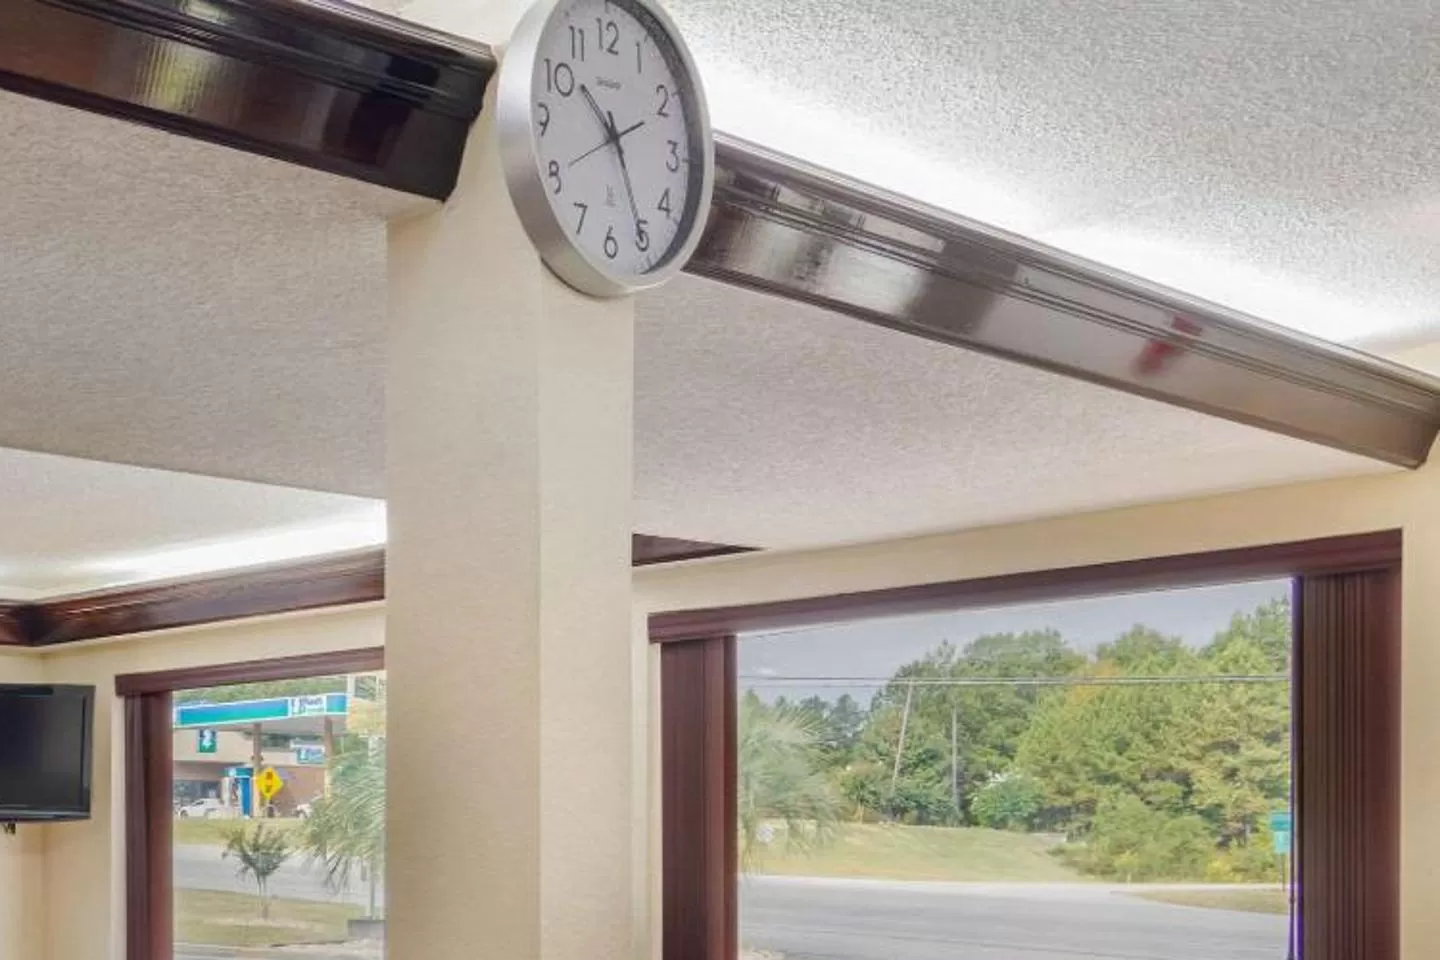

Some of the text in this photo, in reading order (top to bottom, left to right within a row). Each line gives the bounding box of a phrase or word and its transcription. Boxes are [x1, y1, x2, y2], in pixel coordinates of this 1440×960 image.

[569, 26, 584, 61] 11
[596, 18, 619, 55] 12
[635, 42, 641, 74] 1
[544, 58, 574, 97] 10
[656, 84, 669, 117] 2
[537, 103, 550, 136] 9
[666, 140, 679, 173] 3
[548, 160, 561, 194] 8
[573, 202, 588, 235] 7
[657, 188, 670, 218] 4
[604, 226, 618, 259] 6
[635, 219, 650, 251] 5
